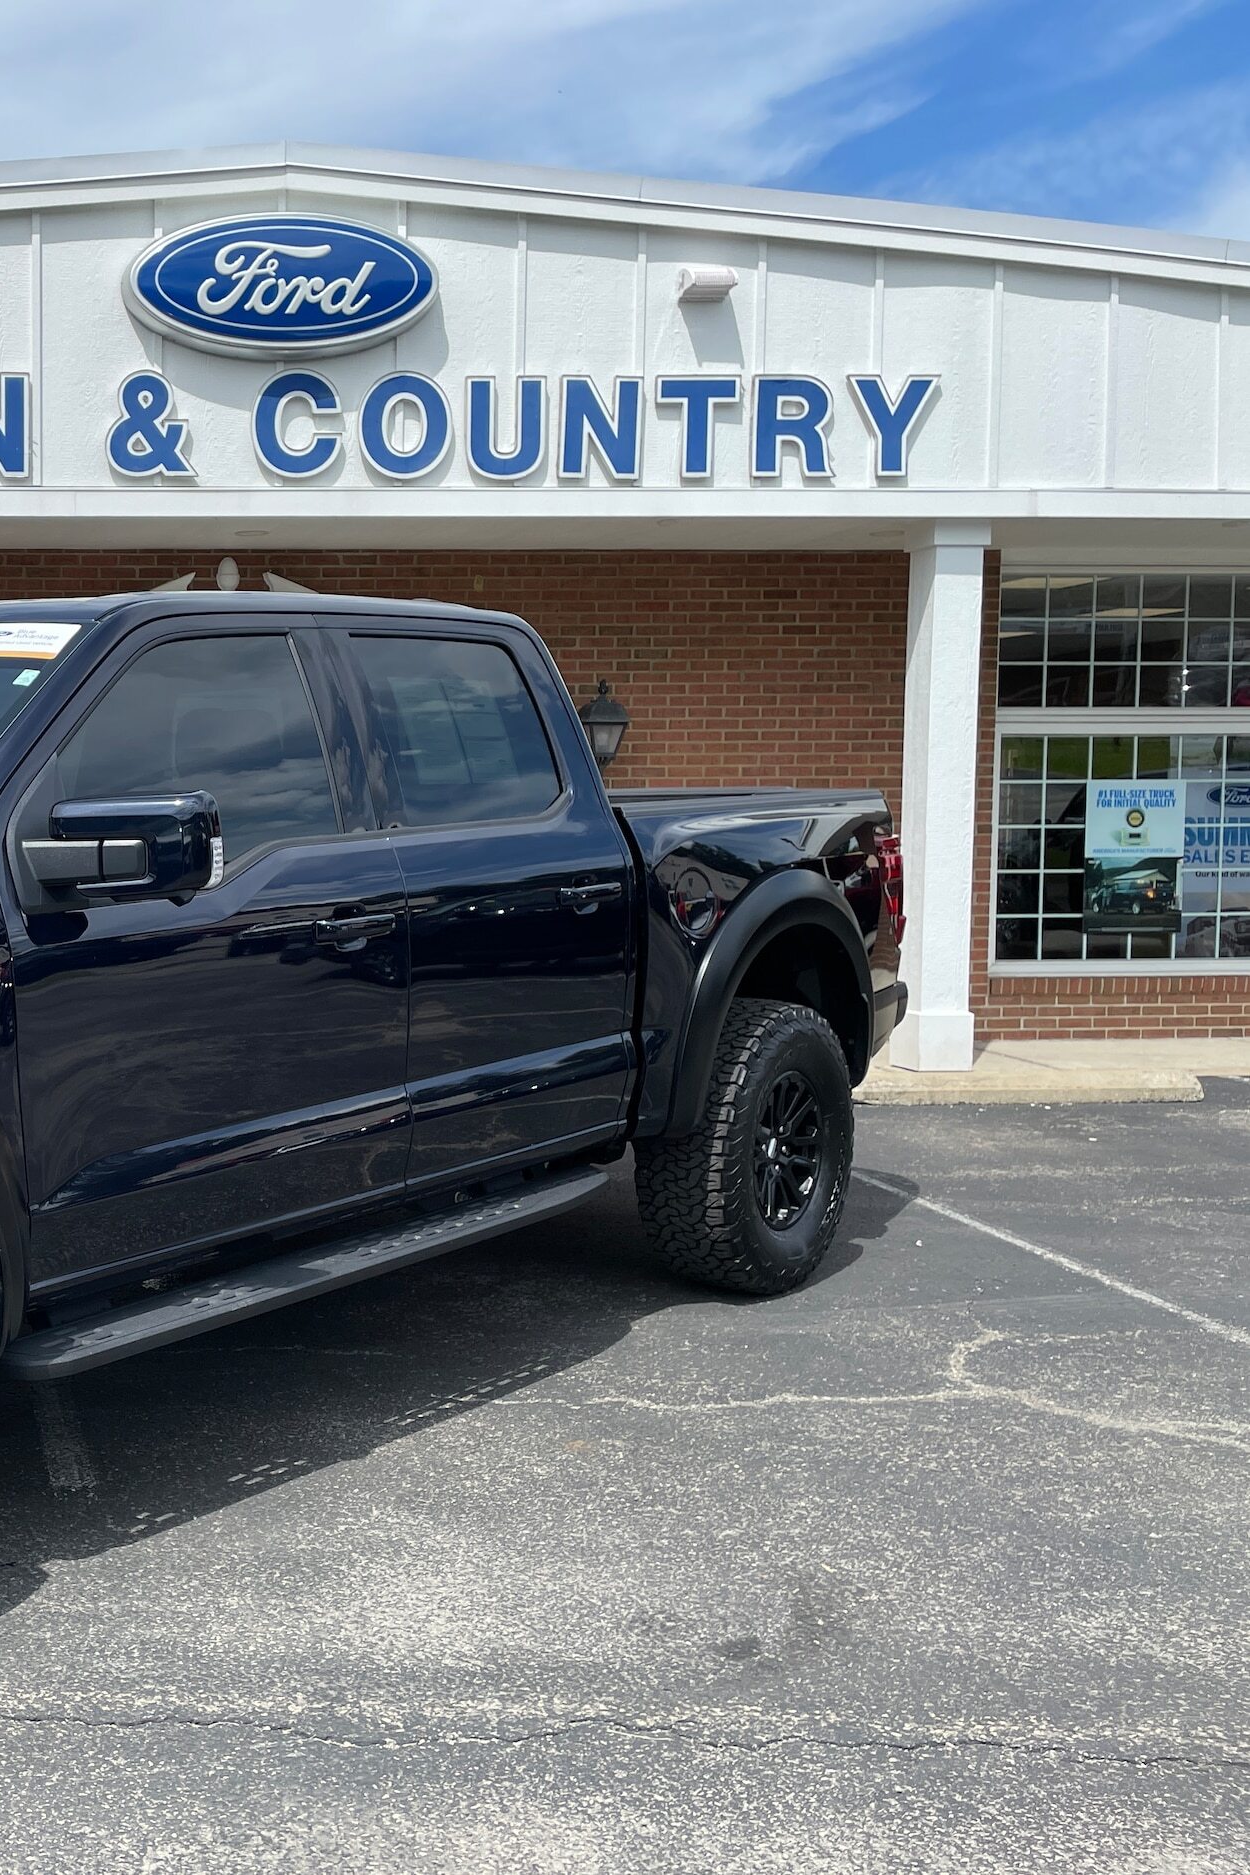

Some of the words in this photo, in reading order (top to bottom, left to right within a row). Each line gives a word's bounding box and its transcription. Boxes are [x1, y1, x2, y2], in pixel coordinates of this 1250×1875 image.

[197, 240, 376, 317] Ford
[105, 368, 198, 478] &
[251, 368, 941, 480] COUNTRY
[1096, 799, 1112, 808] FOR
[1114, 799, 1141, 808] INITIAL
[1143, 799, 1176, 809] QUALITY
[1098, 789, 1107, 798] #1
[1110, 789, 1146, 798] FULL-SIZE
[1149, 789, 1175, 798] TRUCK
